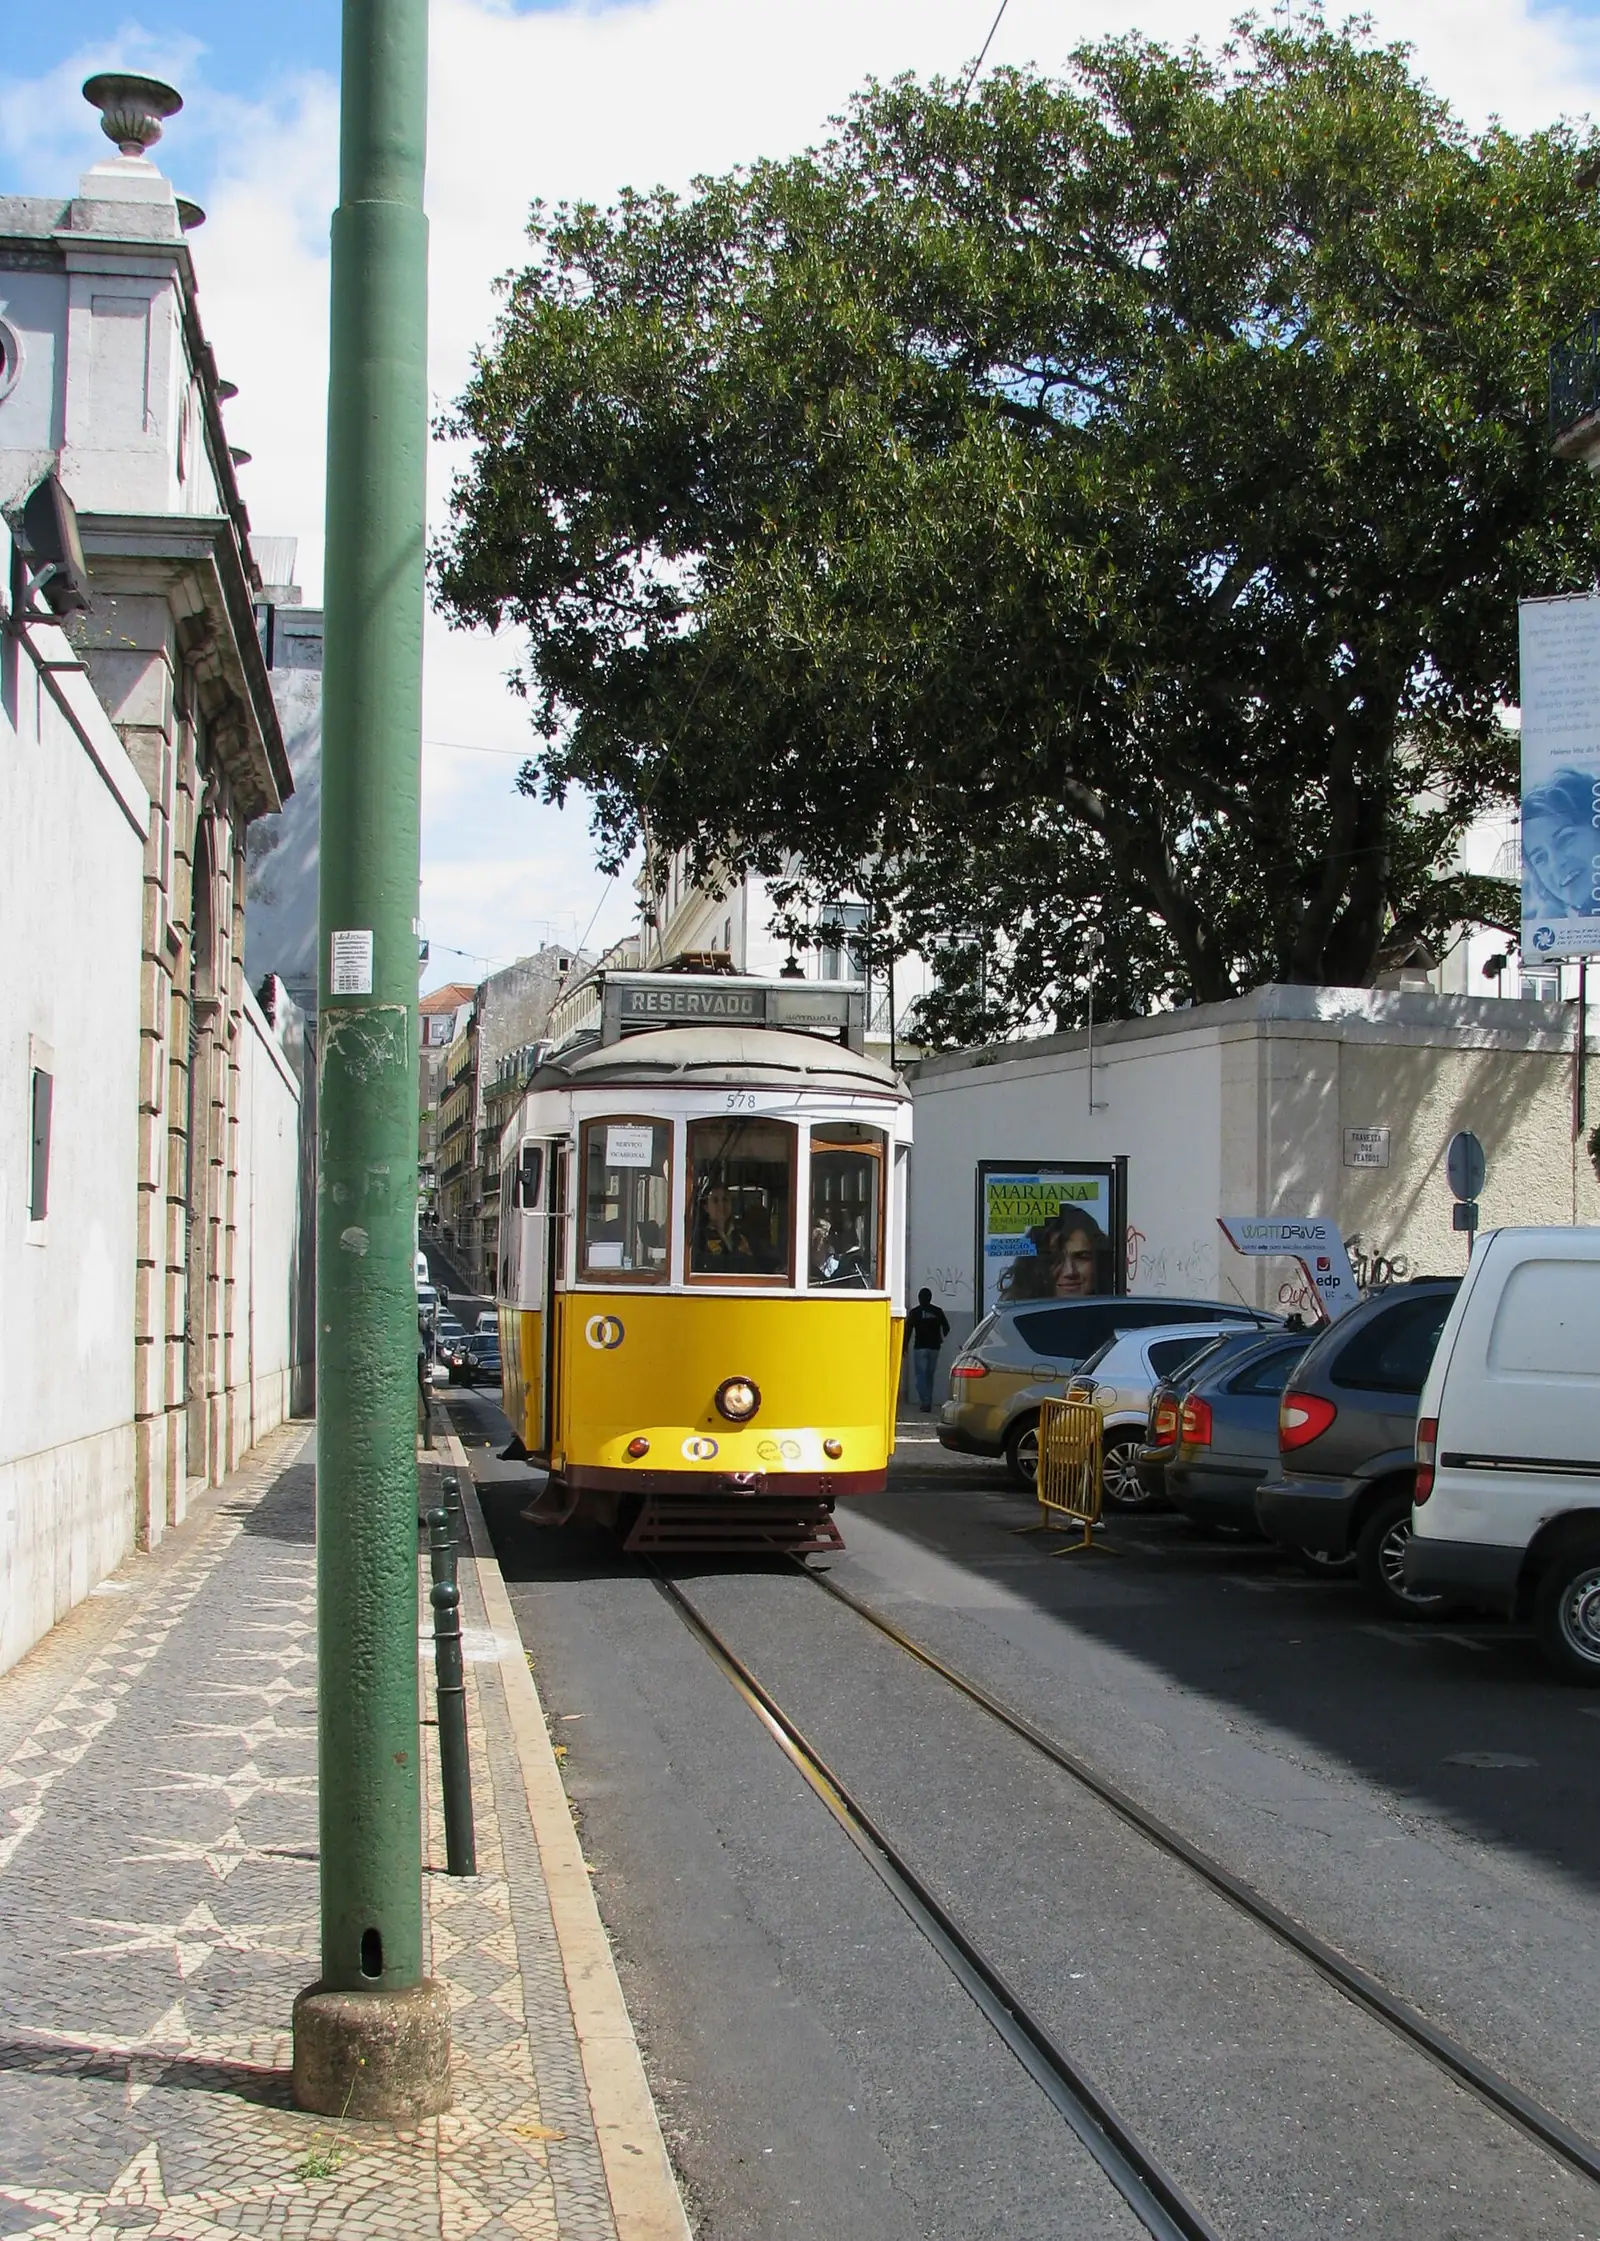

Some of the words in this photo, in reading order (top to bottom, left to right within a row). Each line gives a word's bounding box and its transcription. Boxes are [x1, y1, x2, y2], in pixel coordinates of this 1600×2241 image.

[631, 992, 753, 1014] RESERVADO
[726, 1094, 756, 1109] 578
[990, 1185, 1088, 1200] MARIANA
[990, 1201, 1059, 1215] AYDAR
[1316, 1274, 1341, 1289] edp
